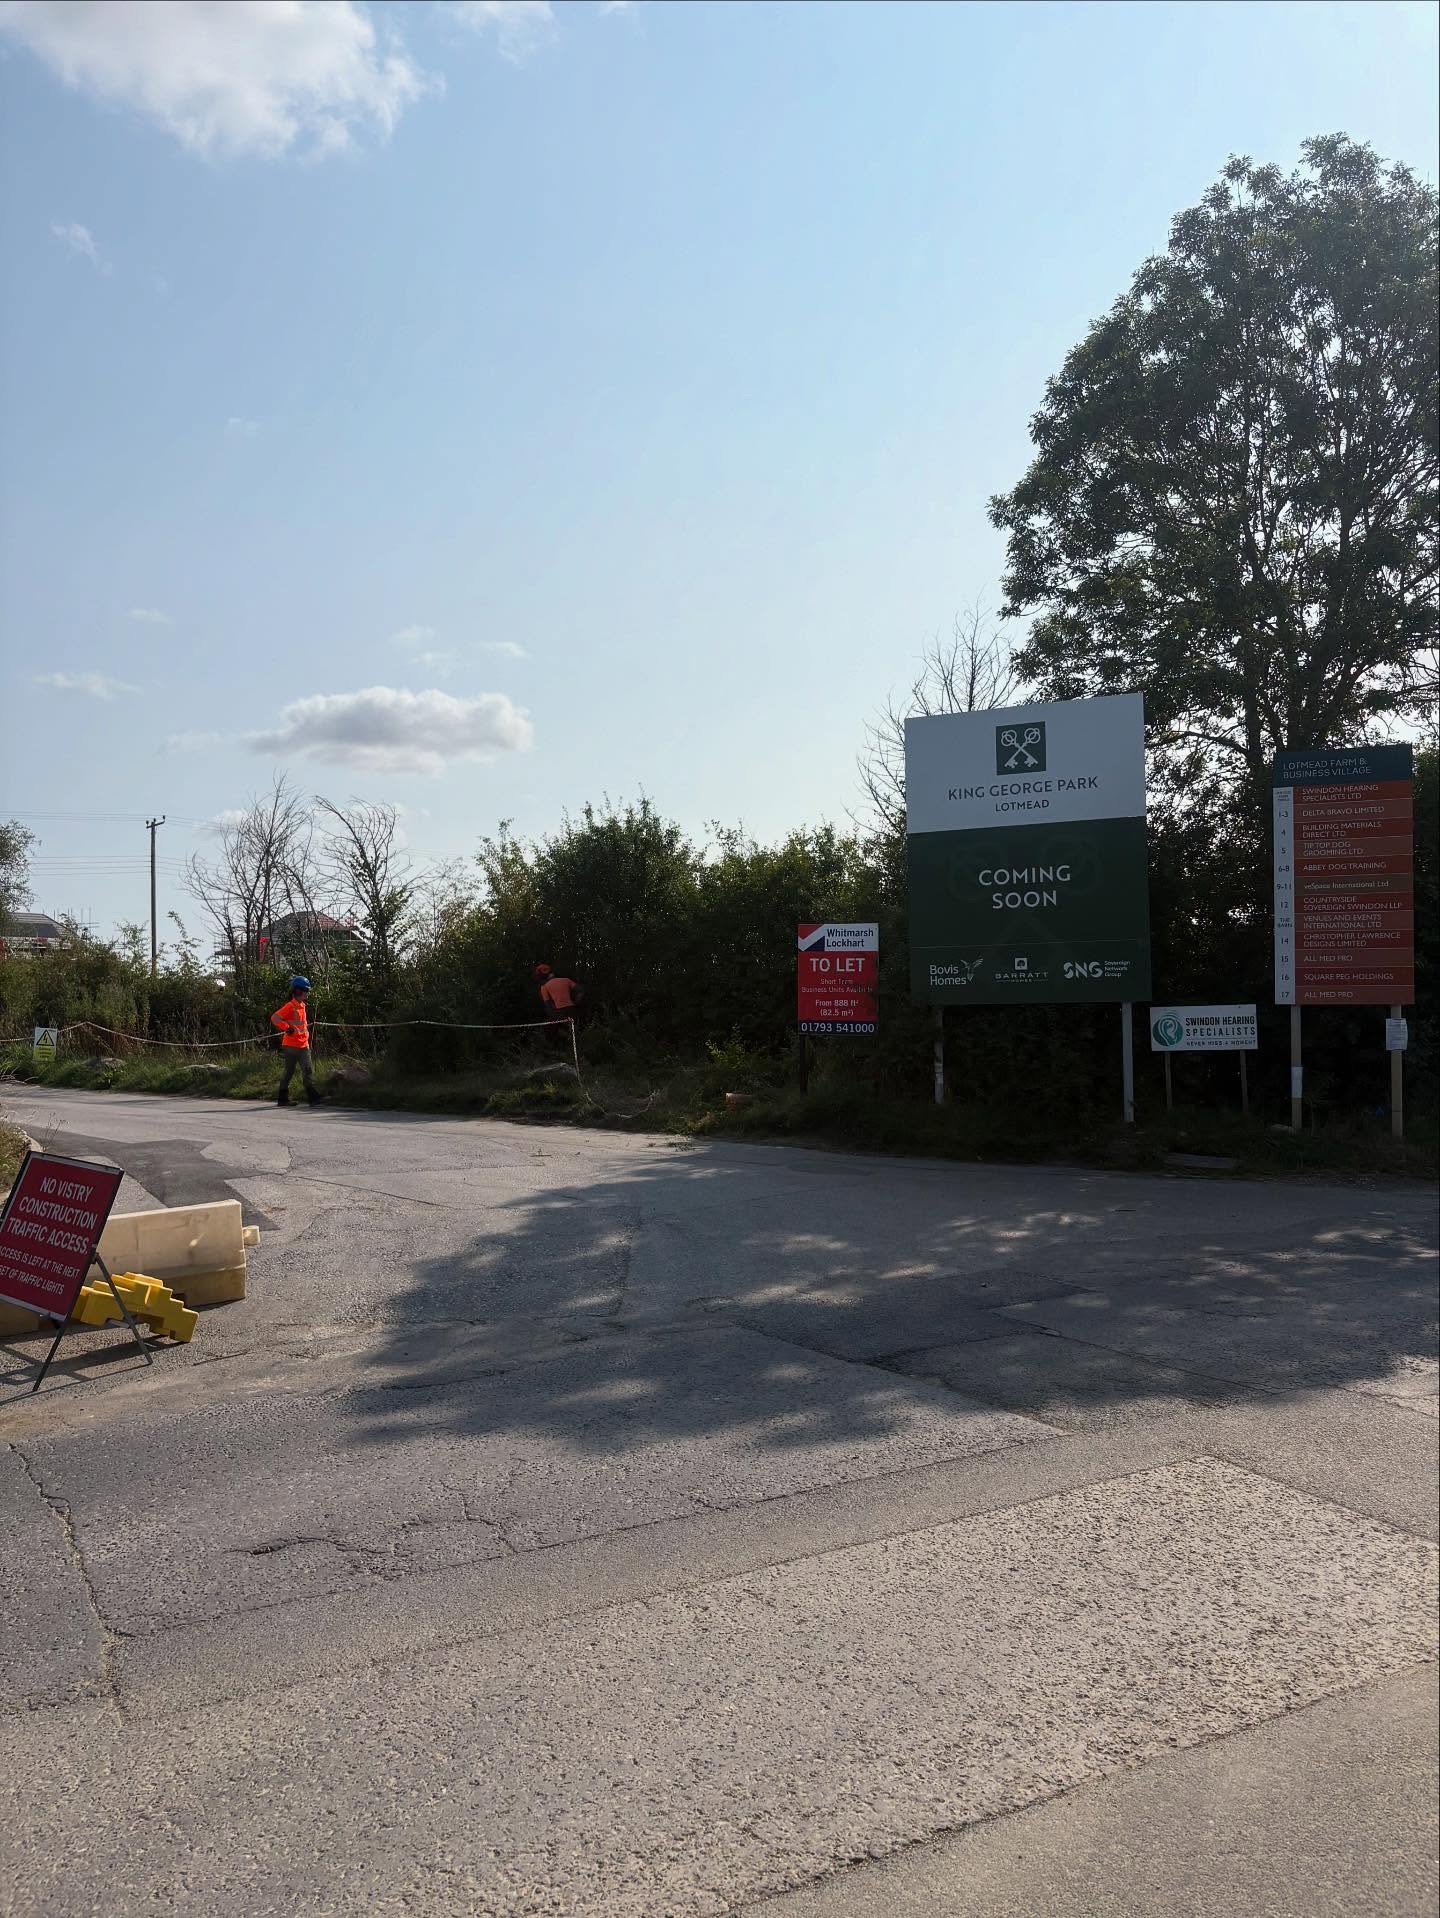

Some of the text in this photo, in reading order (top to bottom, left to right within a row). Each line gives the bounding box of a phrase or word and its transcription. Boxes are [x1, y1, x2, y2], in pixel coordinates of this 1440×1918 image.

[1283, 760, 1327, 770] LOTMEAD
[1330, 758, 1357, 768] FARM
[1283, 767, 1372, 780] BUSINESS VILLAGE
[948, 776, 1098, 801] KING GEORGE PARK
[1302, 784, 1379, 795] SWINDON HEARING
[1302, 792, 1362, 802] SPECIALISTS LTD
[995, 800, 1050, 812] LOTMEAD
[1302, 806, 1385, 817] DELTA BRAVO LIMITED
[1302, 821, 1382, 833] BUILDING MATERIALS
[1281, 829, 1286, 837] 4
[1302, 830, 1346, 840] DIRECT LTD
[1331, 841, 1351, 849] DOG
[1303, 848, 1364, 857] GROOMING LTD
[1303, 861, 1387, 872] ABBEY DOG TRAINING
[978, 865, 1071, 886] COMING
[1332, 880, 1375, 890] International
[1377, 880, 1389, 888] Ltd
[992, 890, 1057, 909] SOON
[1280, 901, 1289, 909] 12
[1303, 896, 1357, 904] COUNTRYSIDE
[1303, 903, 1345, 912] SOVEREIGN
[1346, 902, 1388, 911] SWINDON
[1333, 914, 1351, 922] AND
[1353, 914, 1382, 922] EVENTS
[1303, 921, 1382, 929] INTERNATIONAL LTD
[826, 928, 874, 938] Whitmarsh
[826, 939, 865, 948] Lockhart
[1303, 940, 1336, 948] DESIGNS
[810, 958, 866, 972] TO LET
[929, 964, 959, 975] Bovis
[1063, 961, 1104, 979] SNG
[930, 975, 967, 986] Homes
[1303, 973, 1336, 981] SQUARE
[815, 999, 832, 1007] From
[834, 999, 848, 1007] 888
[820, 1008, 840, 1017] (82.5
[1185, 1015, 1255, 1026] SWINDON HEARING
[801, 1022, 875, 1033] 01793 541000
[1185, 1026, 1256, 1037] SPECIALISTS
[40, 1177, 94, 1203] NO VISTRY
[18, 1196, 98, 1230] CONSTRUCTION
[6, 1217, 90, 1255] TRAFFIC ACCESS.
[0, 1246, 81, 1279] CCESS IS LEFT AT THE NEXT
[9, 1268, 19, 1279] OF
[17, 1271, 43, 1288] TRAFFIC
[41, 1278, 65, 1295] LIGHTS
